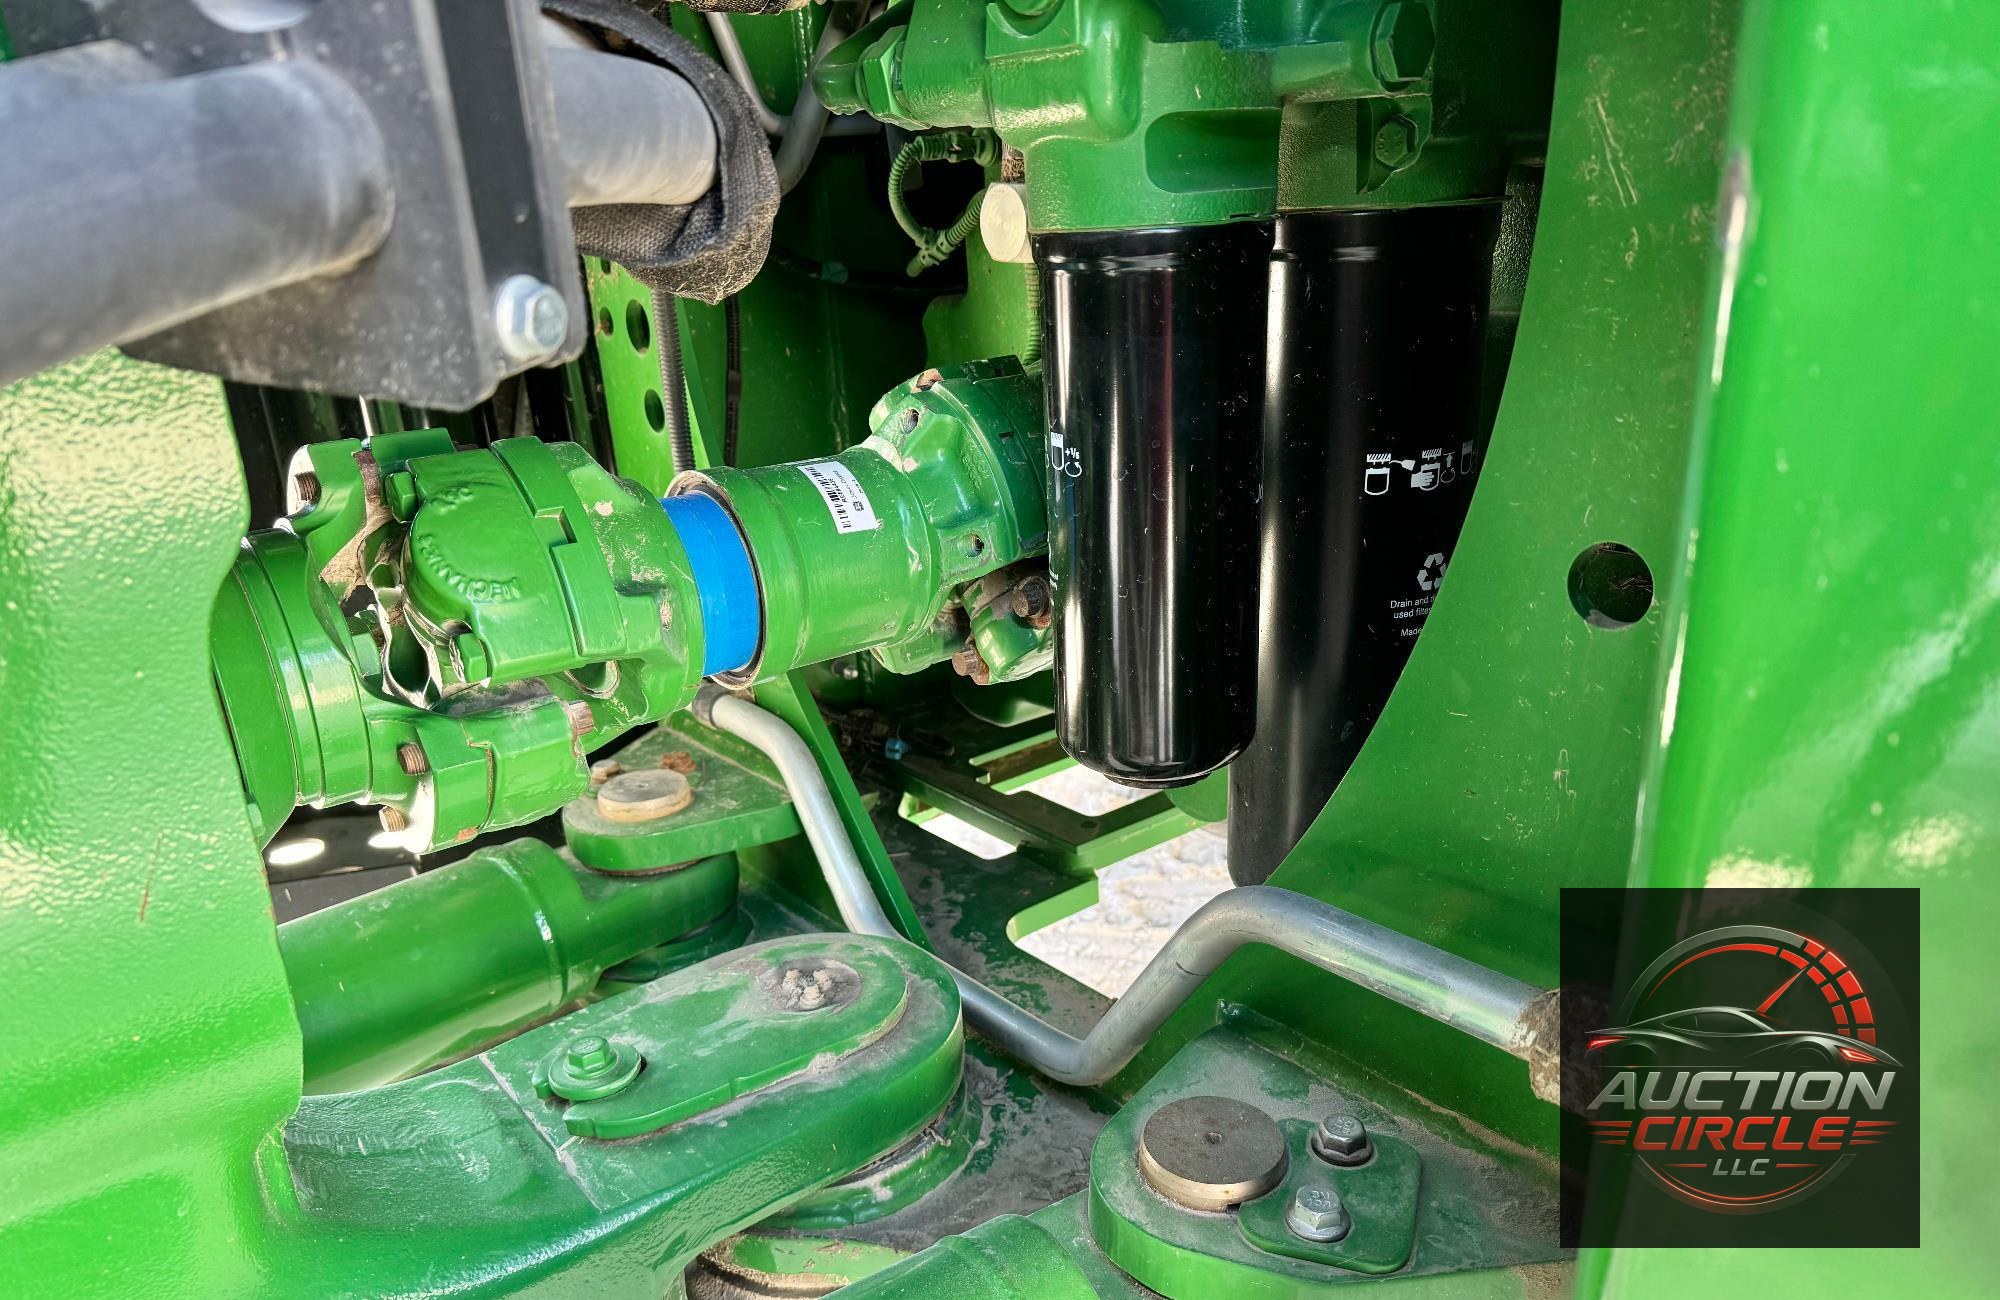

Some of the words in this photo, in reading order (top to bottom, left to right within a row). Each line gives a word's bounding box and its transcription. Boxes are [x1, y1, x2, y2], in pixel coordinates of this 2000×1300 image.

[1390, 598, 1413, 609] Drain
[1414, 595, 1429, 606] and
[1393, 608, 1414, 619] used
